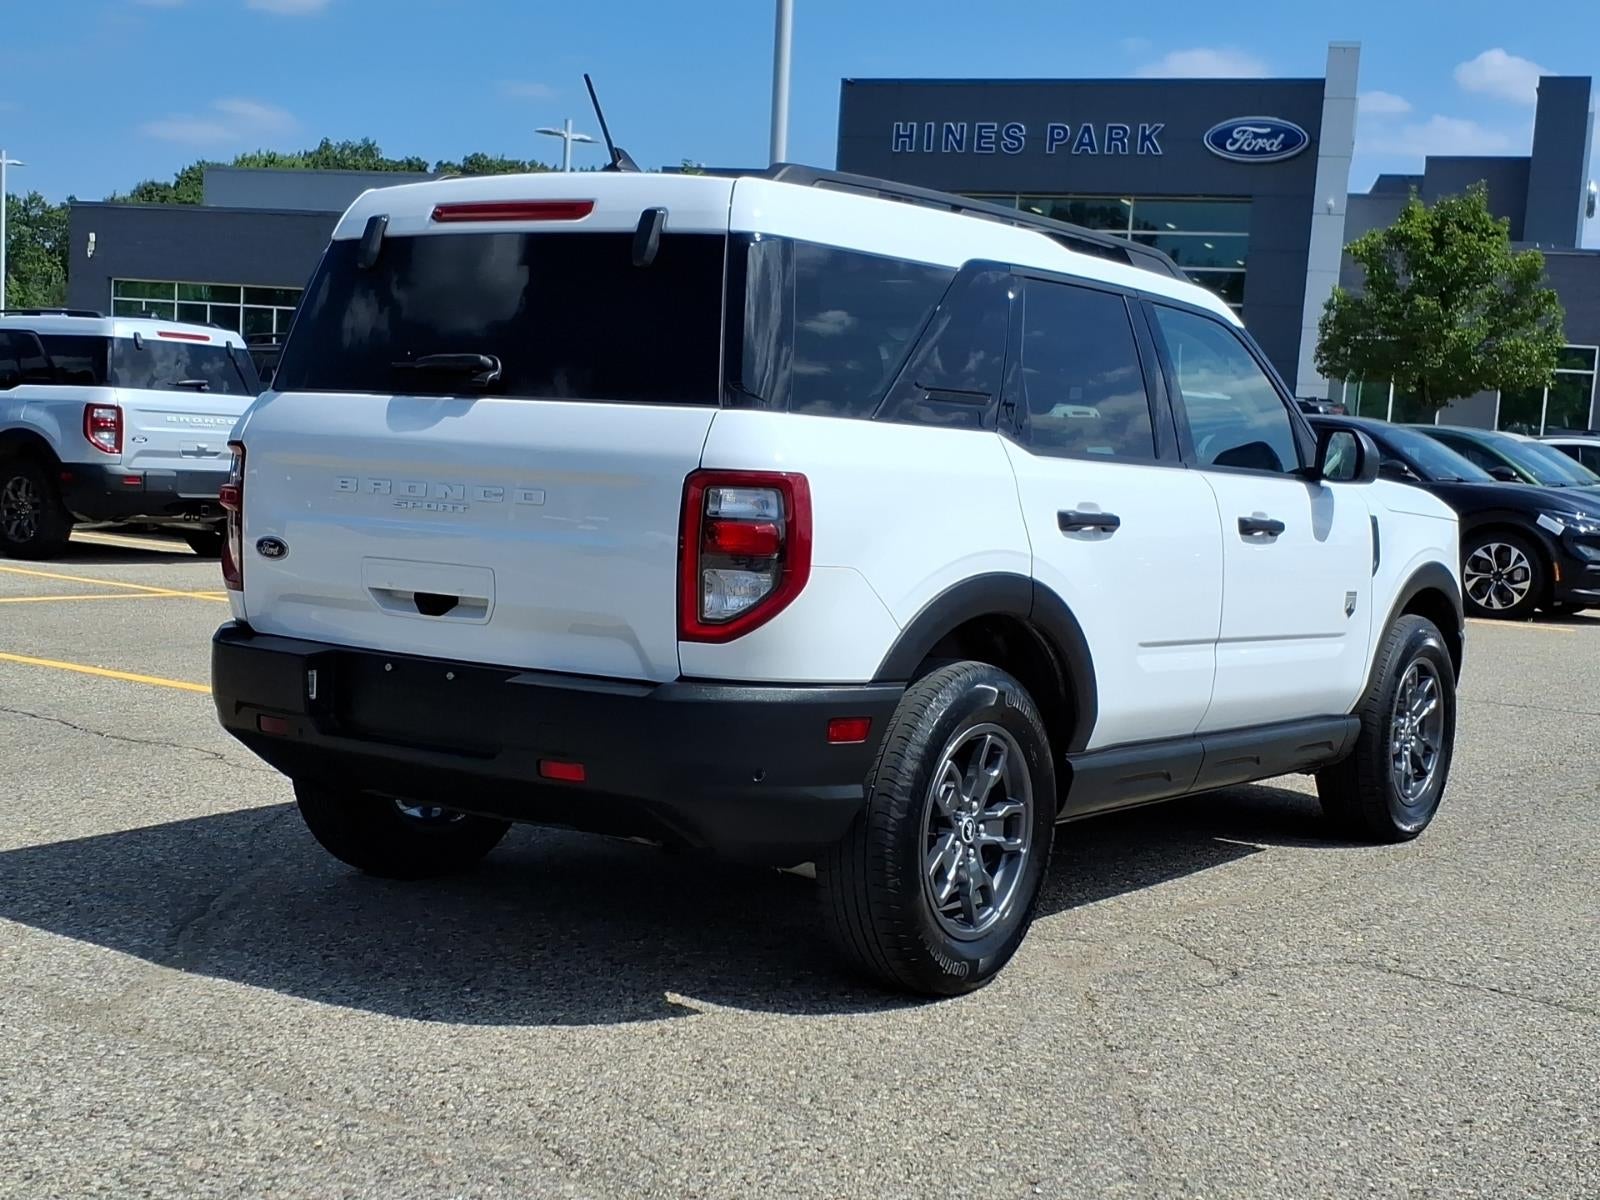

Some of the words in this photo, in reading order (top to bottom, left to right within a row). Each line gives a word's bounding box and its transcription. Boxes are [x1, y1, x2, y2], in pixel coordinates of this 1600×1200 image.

[892, 121, 1026, 155] HINES
[1046, 123, 1165, 155] PARK
[1225, 125, 1284, 151] Ford
[335, 475, 546, 505] BRONCO
[392, 499, 471, 513] SPORT
